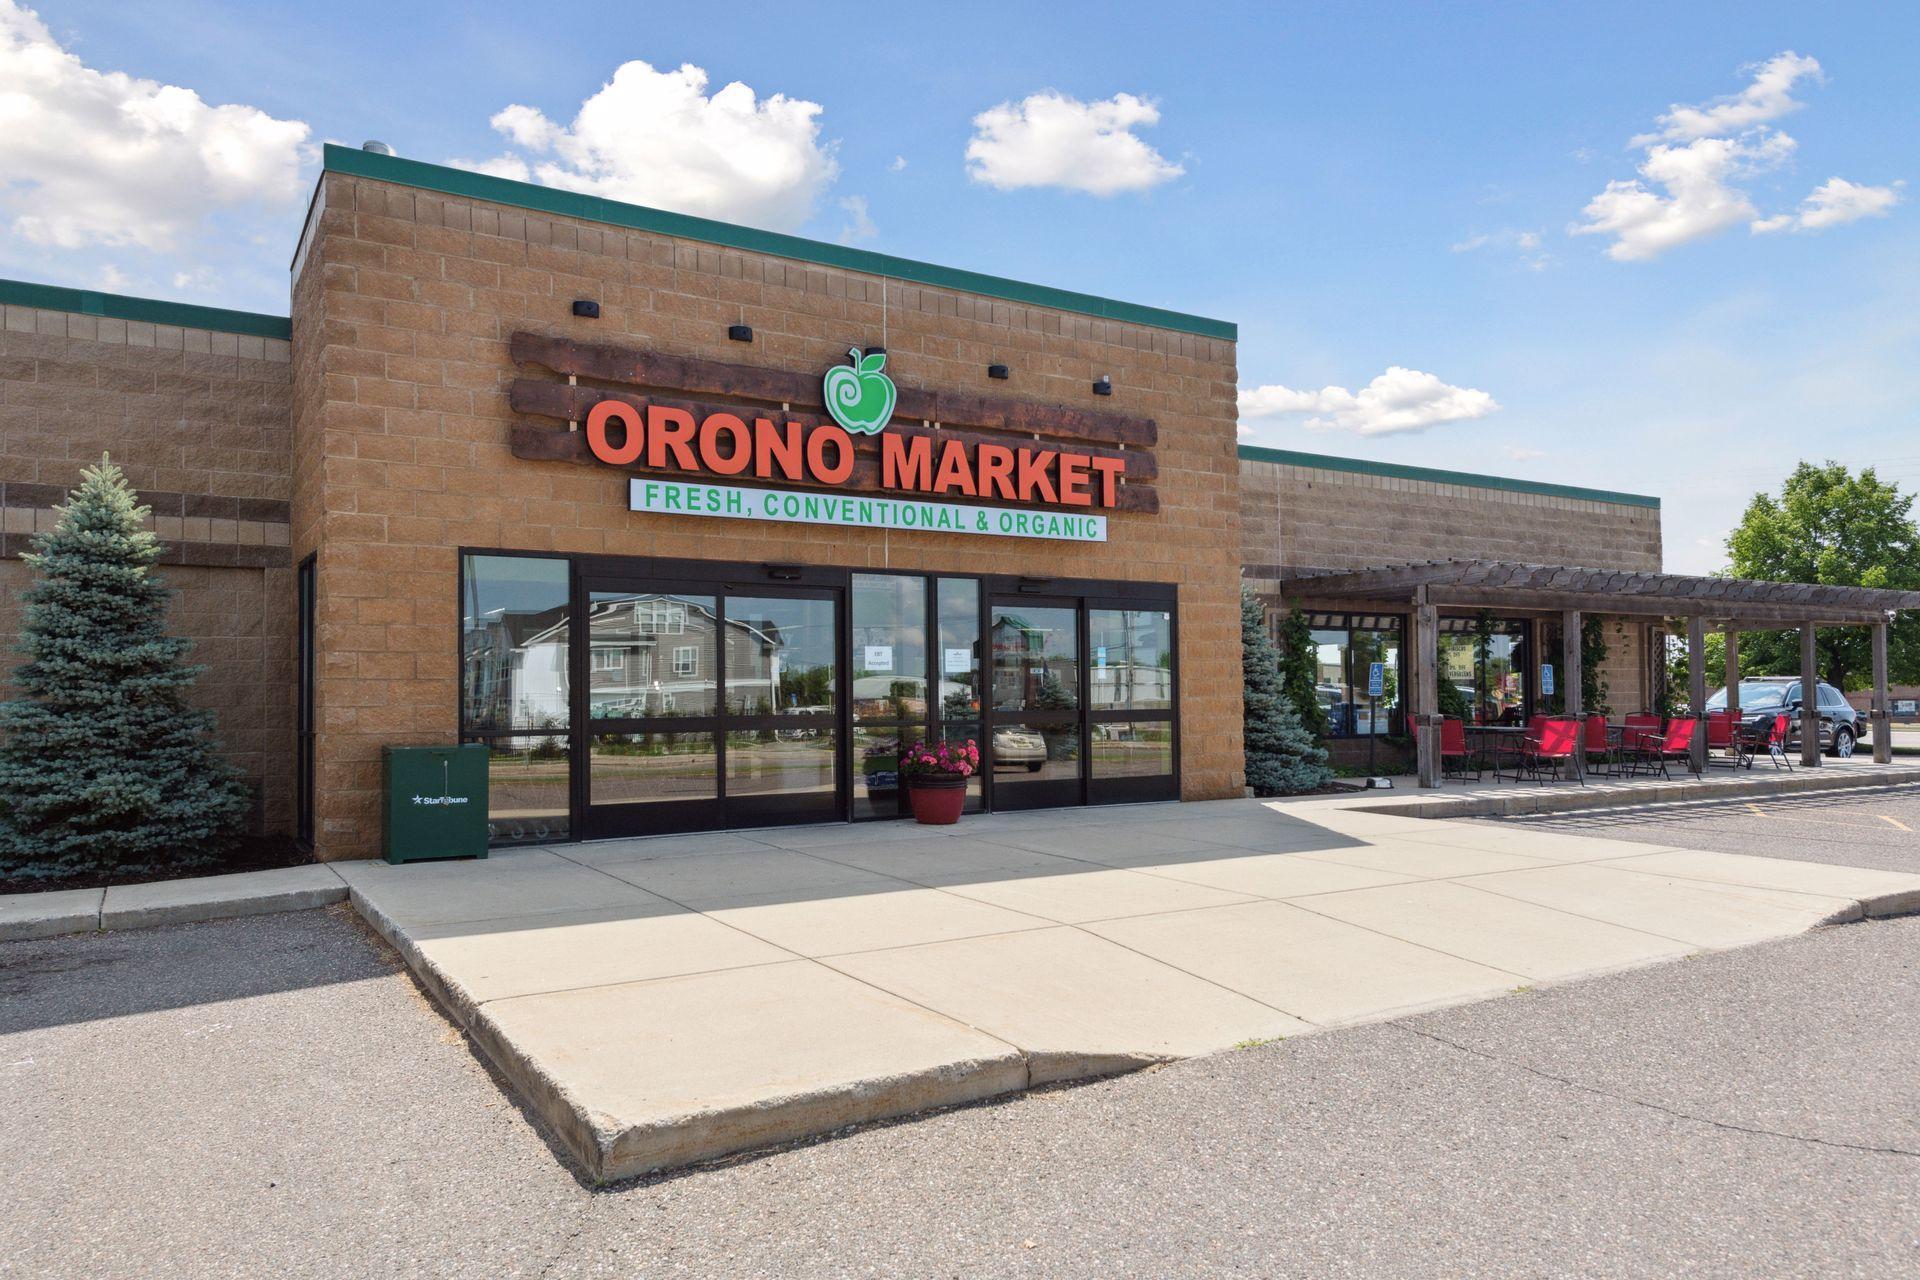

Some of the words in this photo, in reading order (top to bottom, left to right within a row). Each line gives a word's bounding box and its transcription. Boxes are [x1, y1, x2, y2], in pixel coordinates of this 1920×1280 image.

[586, 400, 855, 484] ORONO
[881, 432, 1125, 507] MARKET
[645, 483, 752, 517] FRESH,
[763, 493, 966, 530] CONVENTIONAL
[976, 510, 989, 531] &
[999, 512, 1097, 538] ORGANIC
